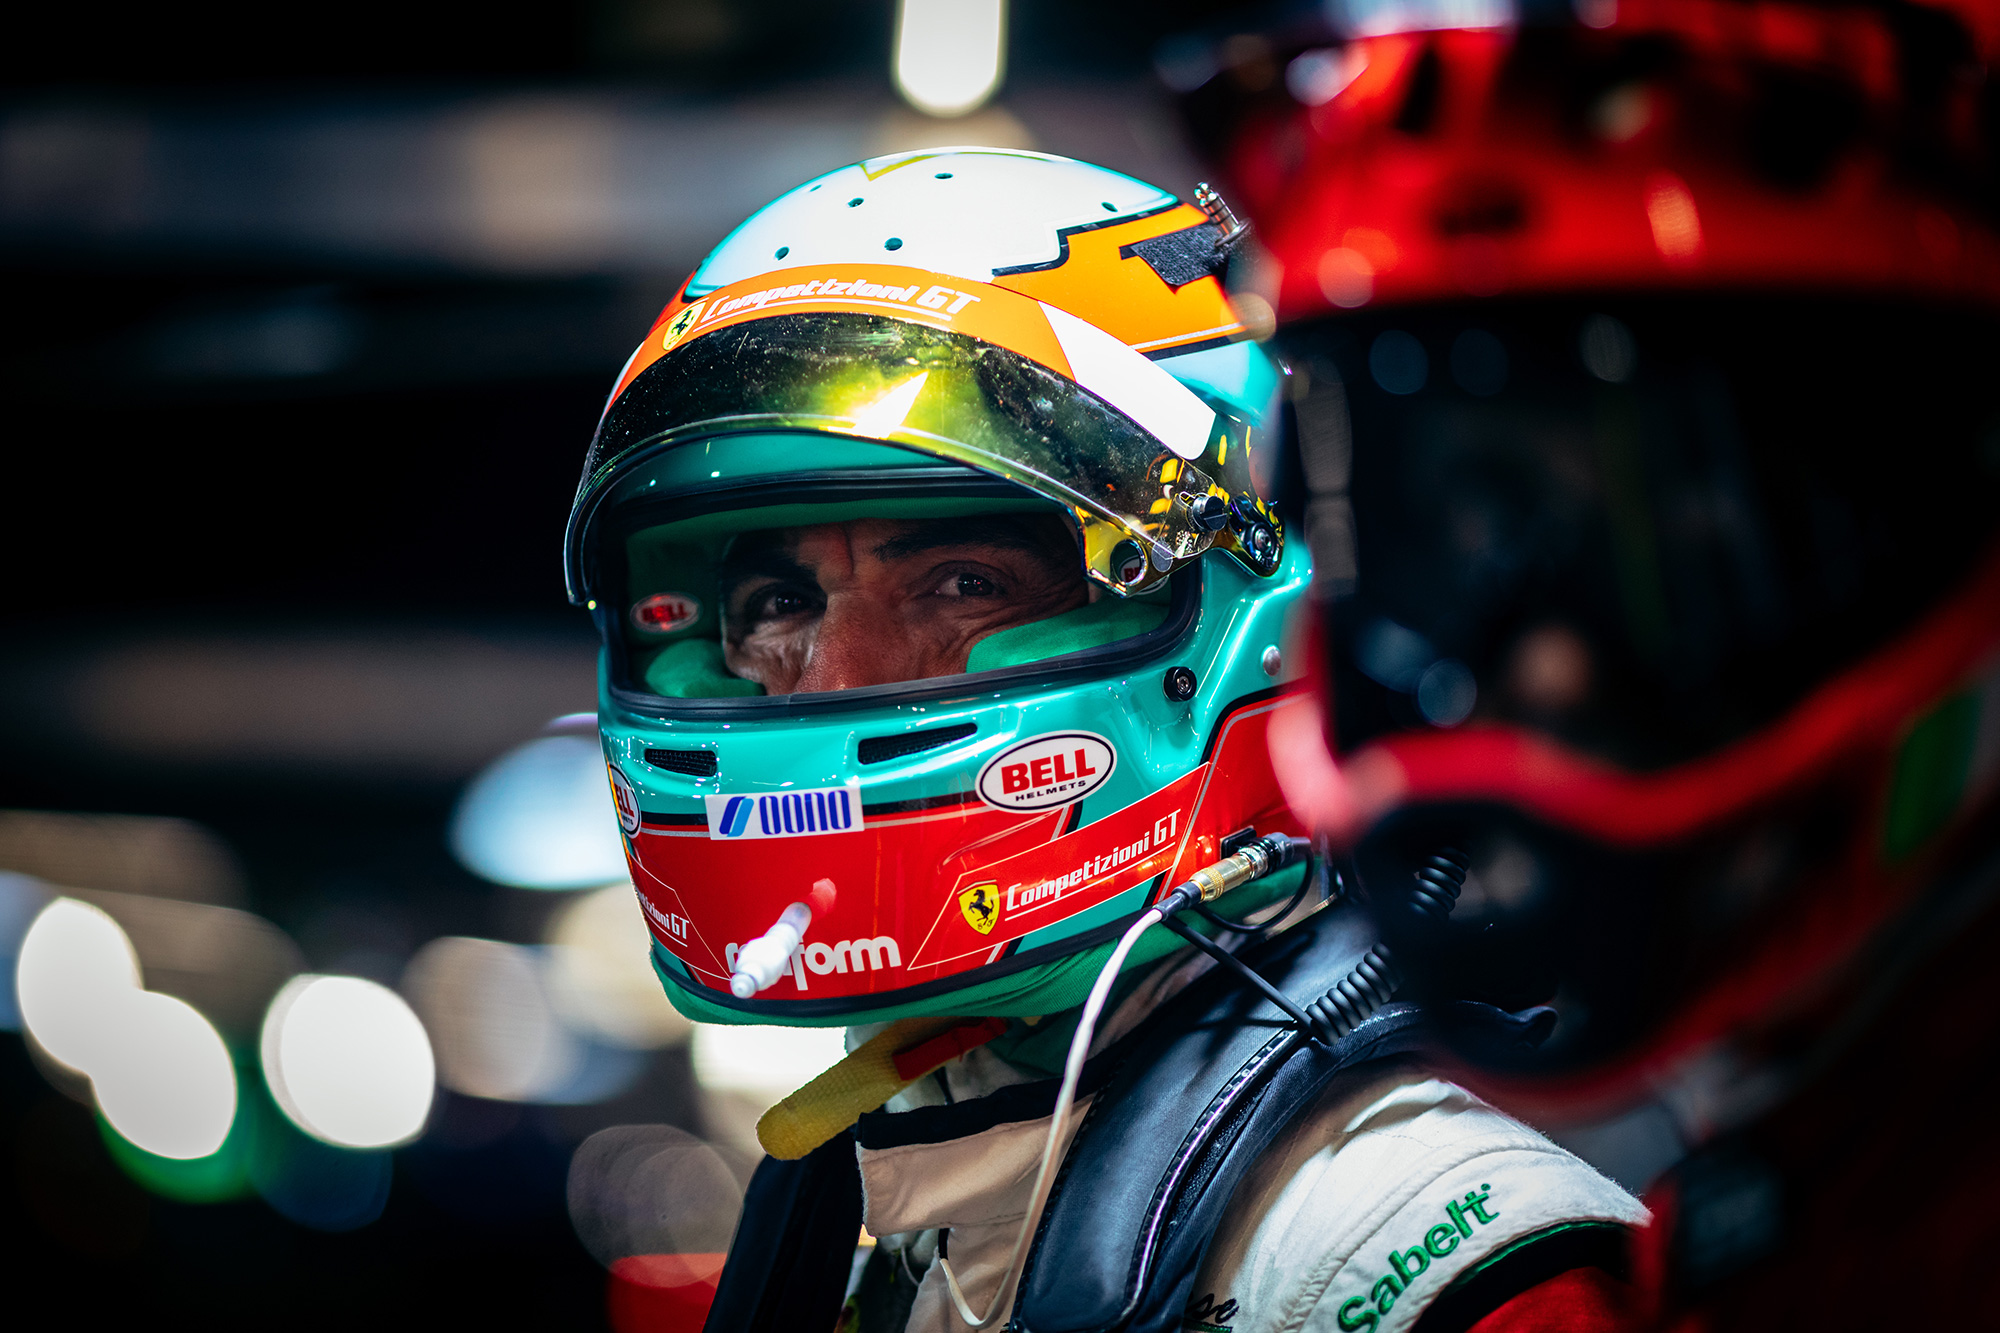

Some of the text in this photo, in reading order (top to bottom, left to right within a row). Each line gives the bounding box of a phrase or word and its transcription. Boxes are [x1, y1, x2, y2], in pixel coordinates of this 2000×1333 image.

[700, 278, 981, 323] Competizioni GT
[1001, 748, 1096, 795] BELL
[1015, 780, 1087, 802] HELMETS
[1006, 808, 1182, 912] Competizioni GT
[670, 912, 690, 940] GT
[1337, 1183, 1500, 1333] Sabelt
